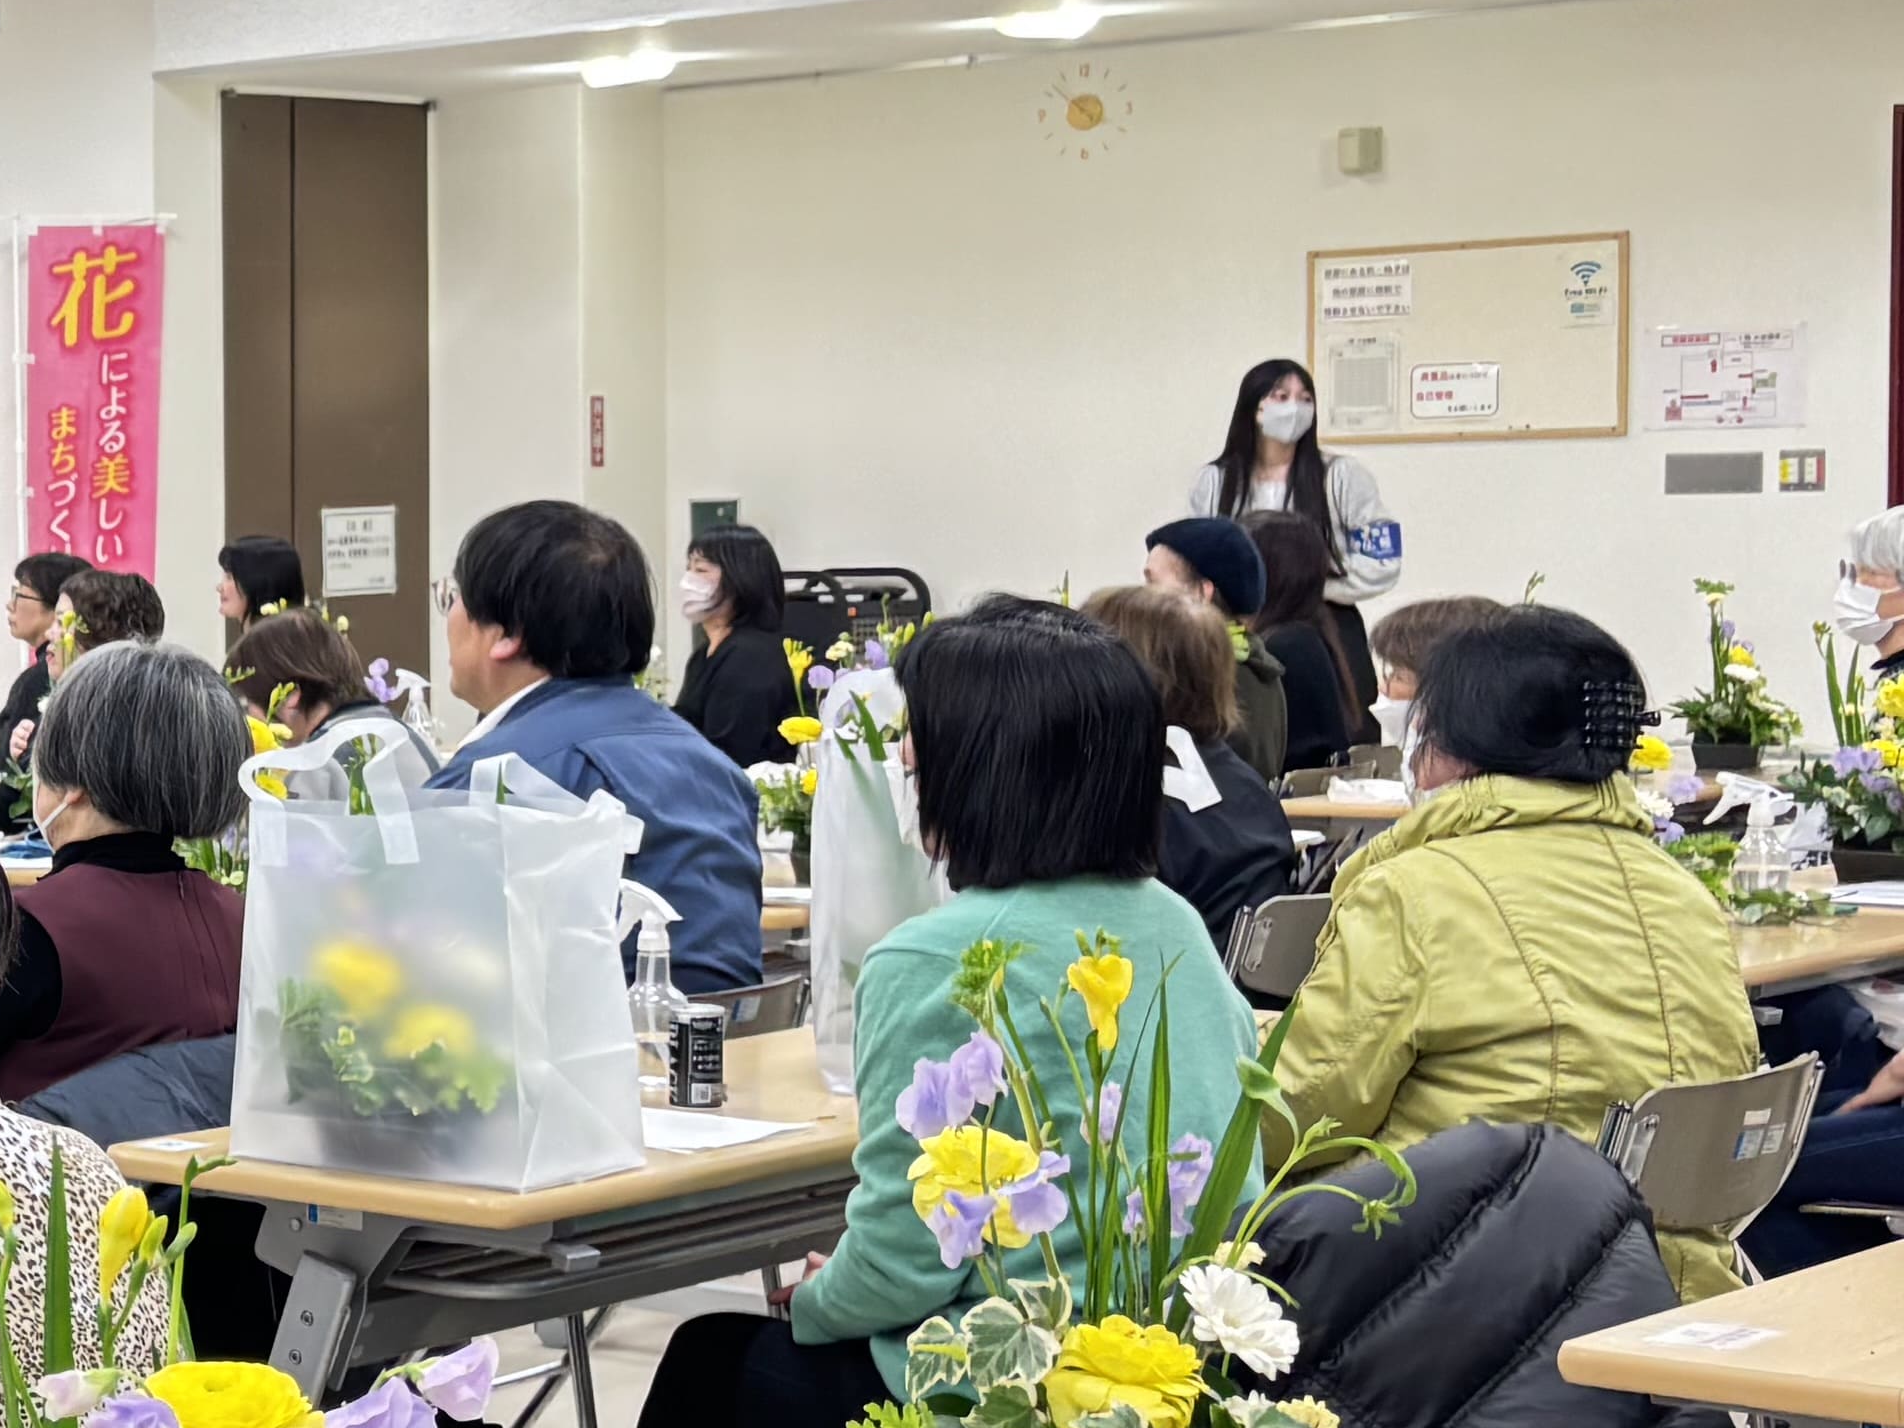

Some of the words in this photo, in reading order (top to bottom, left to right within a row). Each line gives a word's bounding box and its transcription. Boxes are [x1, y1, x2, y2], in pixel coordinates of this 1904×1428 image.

[47, 405, 80, 554] まちづく
[50, 244, 139, 564] 花による美しい
